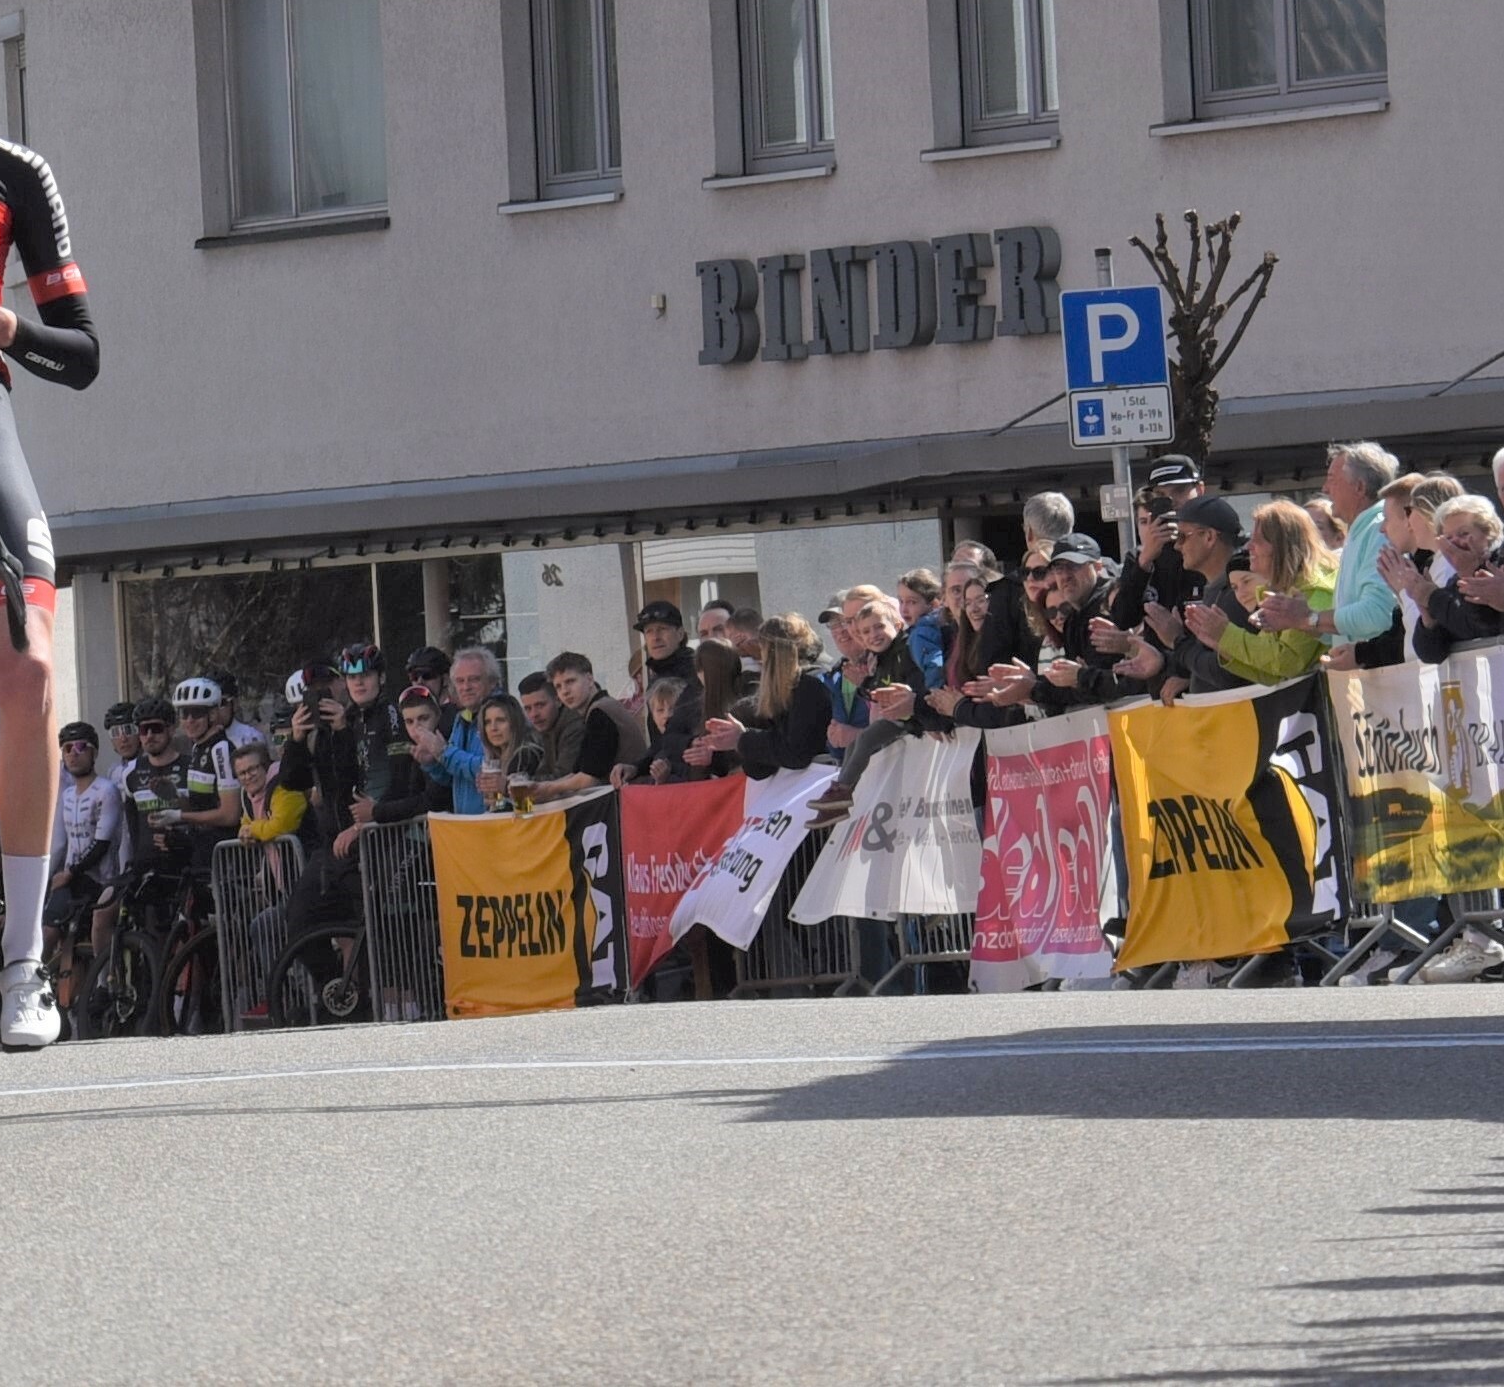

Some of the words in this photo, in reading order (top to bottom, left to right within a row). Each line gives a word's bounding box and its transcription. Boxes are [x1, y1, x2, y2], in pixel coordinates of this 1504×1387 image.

[696, 225, 1062, 366] BINDER
[1086, 302, 1140, 383] P
[1112, 425, 1122, 435] Sa
[1129, 396, 1149, 406] Std.
[457, 890, 566, 958] ZEPPELIN
